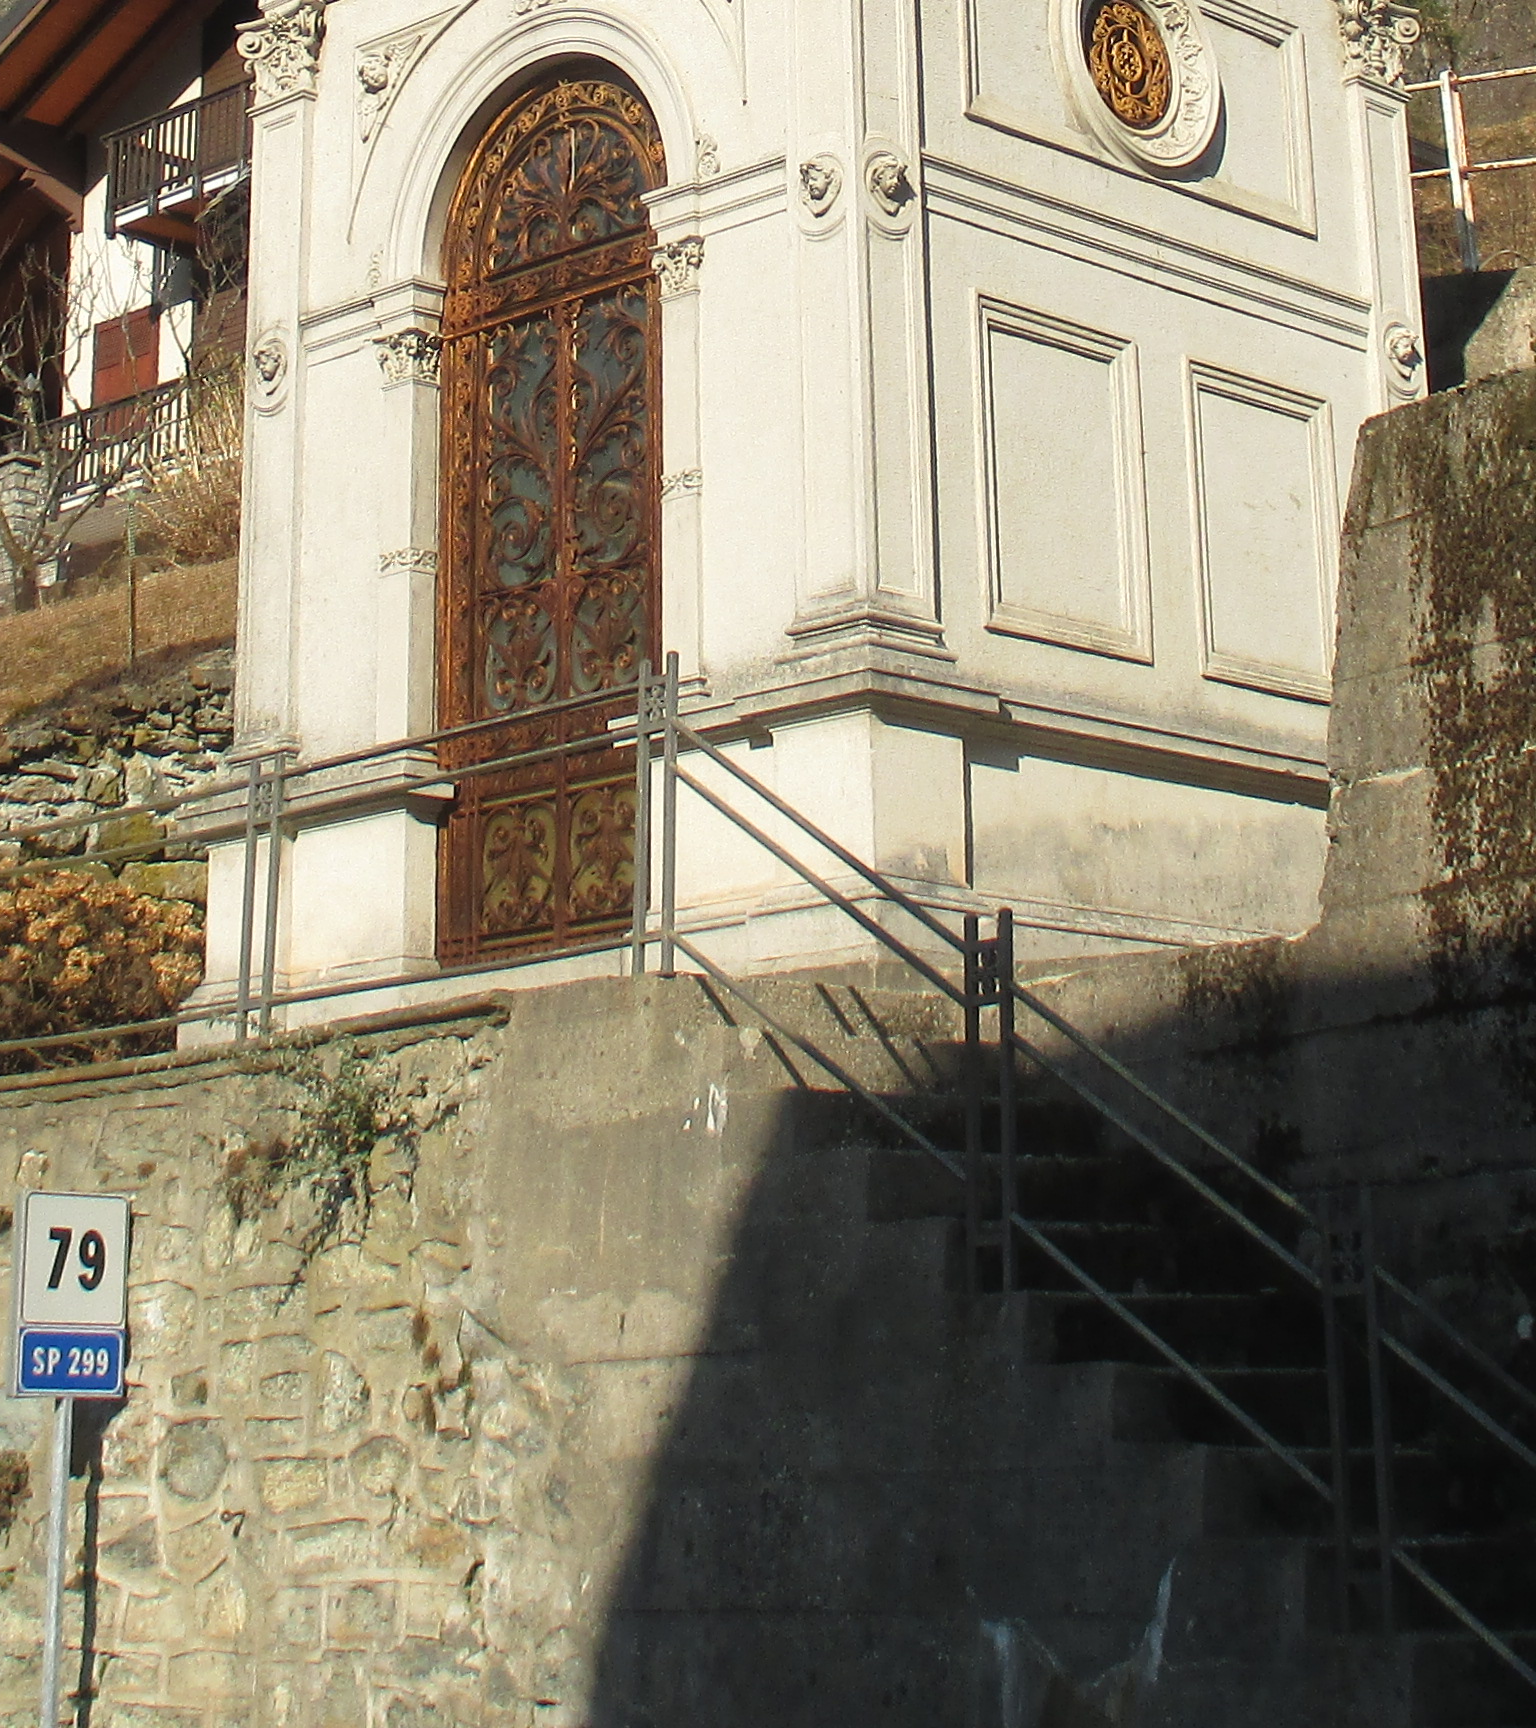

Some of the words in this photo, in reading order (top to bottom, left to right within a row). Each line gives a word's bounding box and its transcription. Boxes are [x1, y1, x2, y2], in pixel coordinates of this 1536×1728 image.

[47, 1227, 107, 1291] 79
[32, 1347, 61, 1376] SP
[68, 1347, 109, 1377] 299
